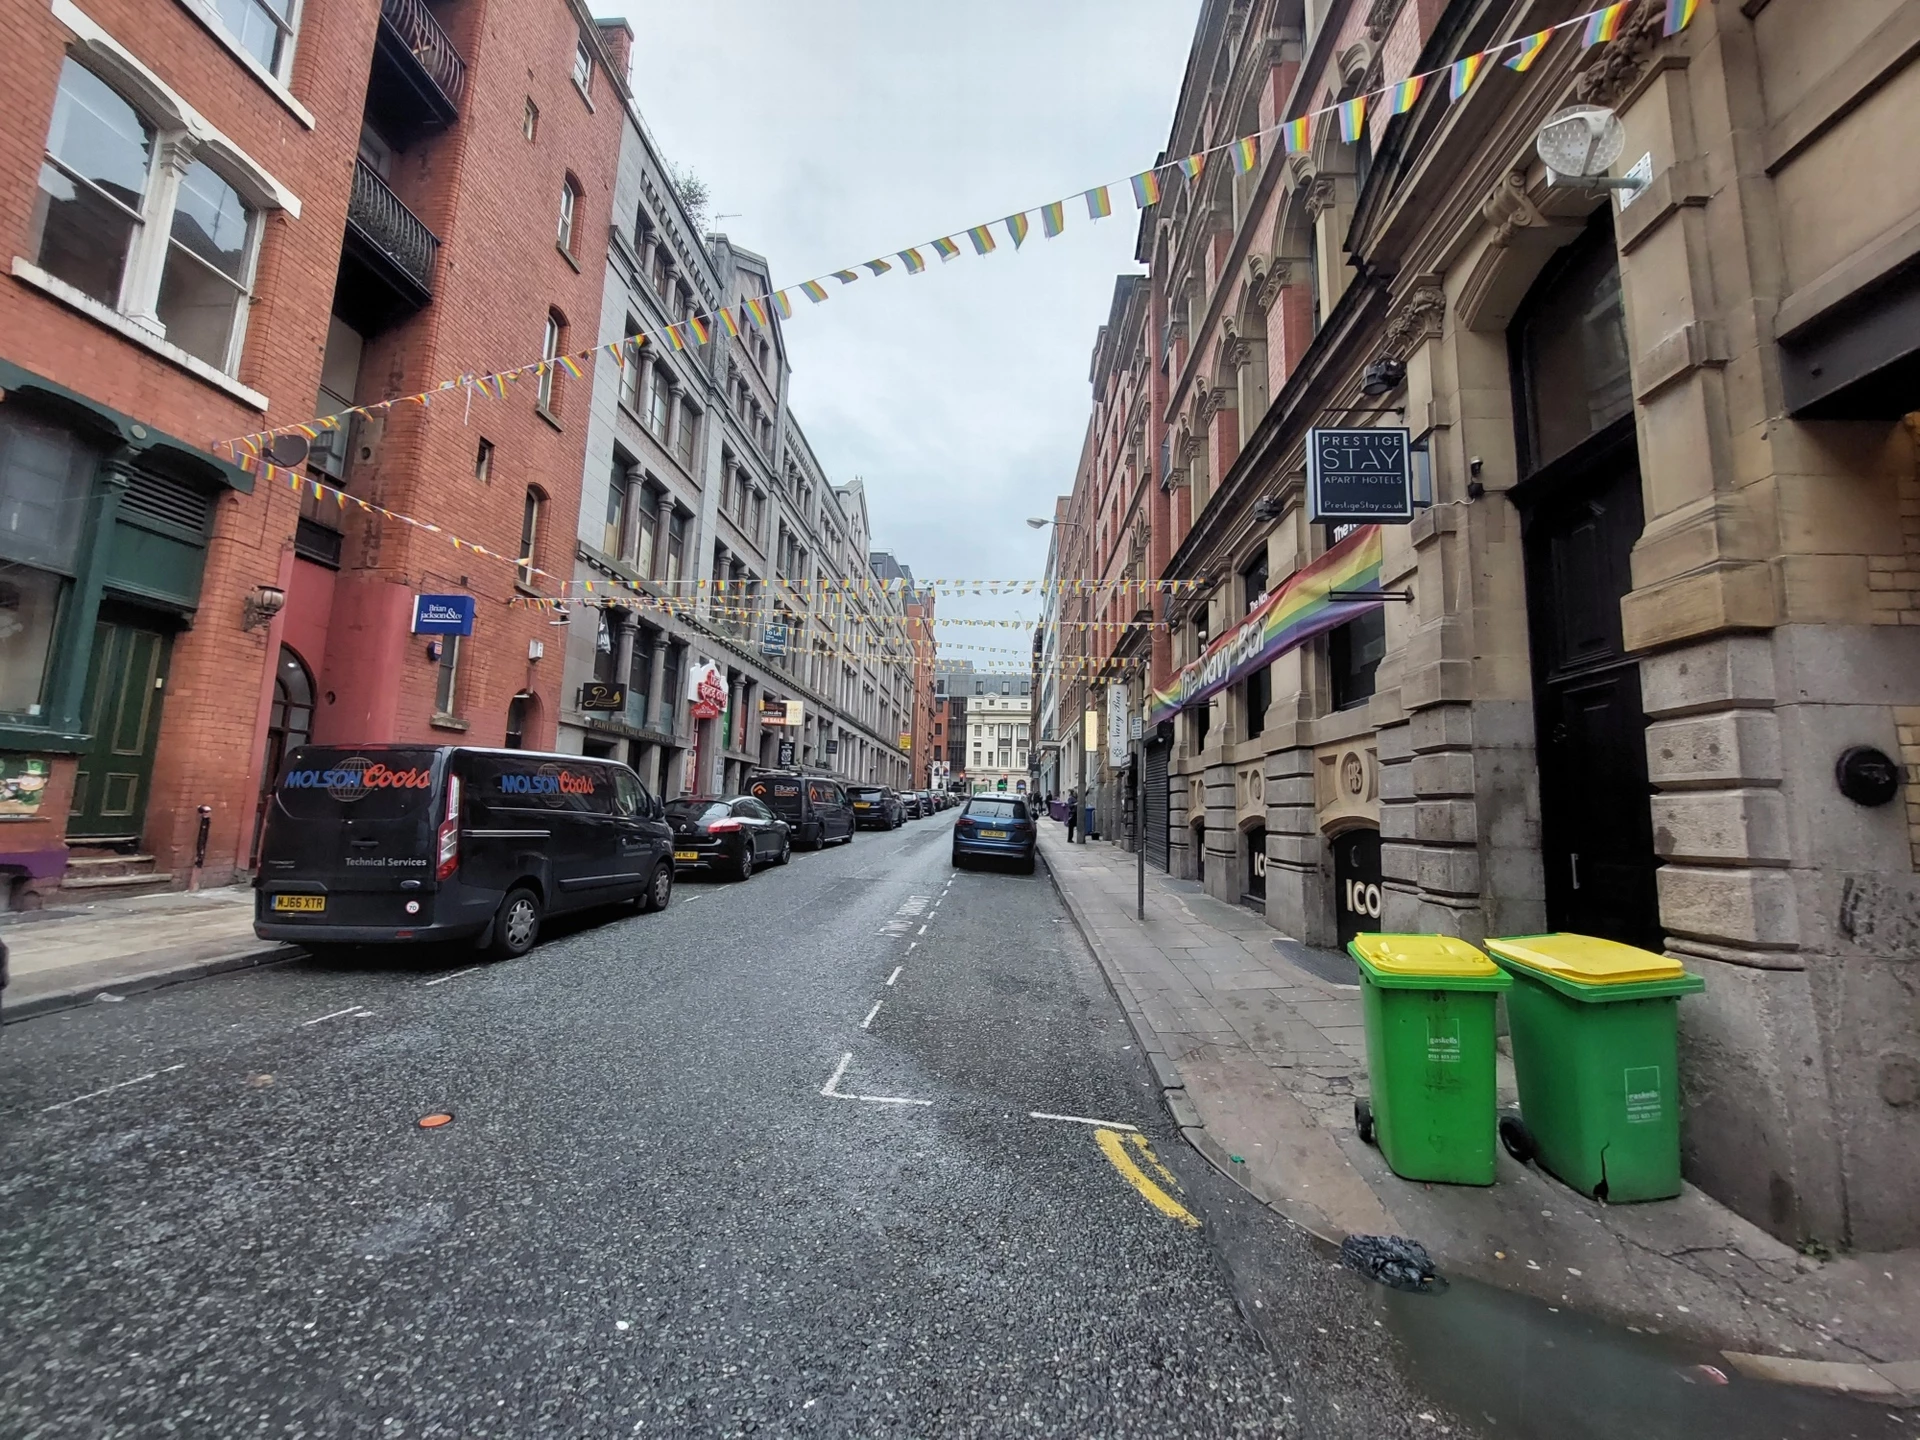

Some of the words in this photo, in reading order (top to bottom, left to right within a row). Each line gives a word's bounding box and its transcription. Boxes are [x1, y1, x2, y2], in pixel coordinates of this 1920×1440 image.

[1322, 436, 1401, 446] PRESTIGE
[1322, 447, 1400, 470] STAY
[1324, 475, 1357, 484] APART
[1362, 475, 1403, 484] HOTELS
[1324, 500, 1404, 511] PrestigeStay.co.uk
[1333, 524, 1349, 543] The
[429, 604, 447, 612] Brian
[1180, 668, 1199, 700] The
[1198, 640, 1237, 689] Navy
[1237, 612, 1269, 666] Bar
[1113, 691, 1121, 713] Bar
[1112, 715, 1124, 738] Navy
[284, 770, 363, 788] MOLSON
[363, 764, 431, 789] Coors
[501, 774, 559, 793] MOLSON
[558, 771, 595, 794] Coors
[345, 857, 386, 867] Technical
[387, 858, 427, 867] Services
[1254, 851, 1266, 877] IC
[303, 896, 323, 908] XTR
[1345, 878, 1381, 919] ICO
[1429, 1037, 1458, 1045] gaskells
